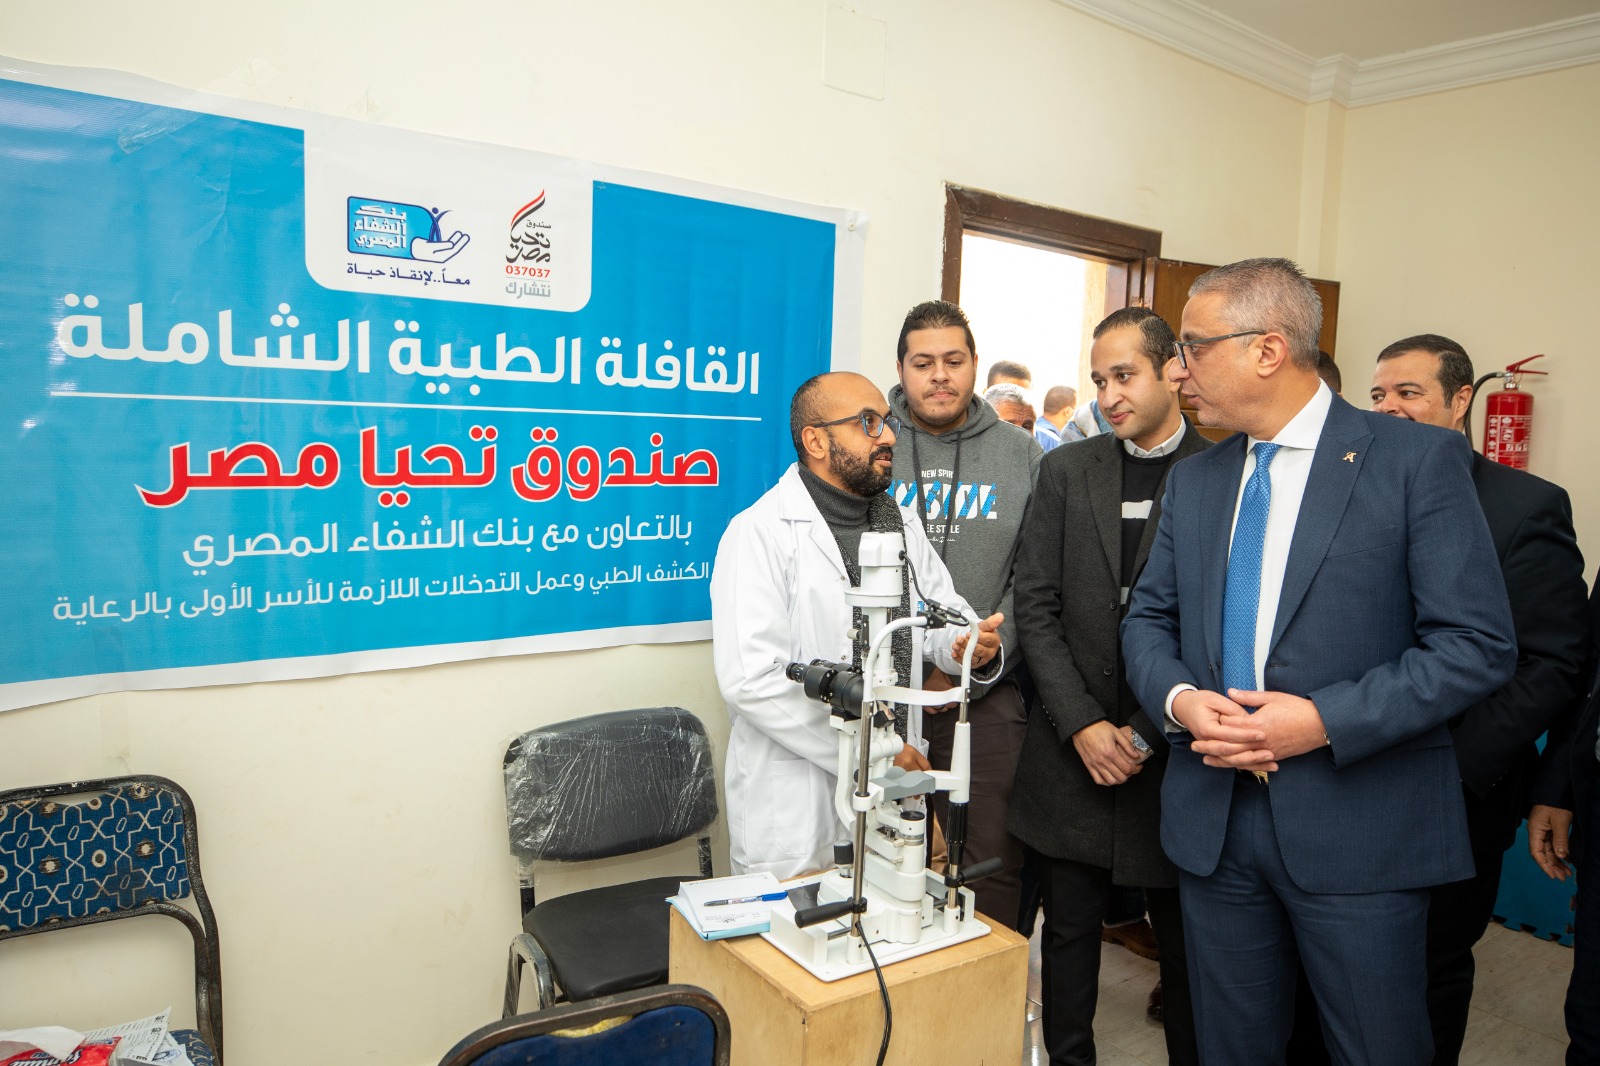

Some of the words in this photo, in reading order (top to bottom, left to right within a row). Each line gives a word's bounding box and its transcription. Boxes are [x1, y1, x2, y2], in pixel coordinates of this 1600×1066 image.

[354, 206, 406, 220] بنك
[354, 216, 406, 236] الشفاء
[526, 220, 551, 229] صندوق
[354, 234, 406, 249] المصري
[347, 262, 386, 279] حياة
[506, 265, 550, 278] 037037
[506, 282, 551, 299] نتشارك
[57, 293, 370, 373] الشاملة
[389, 320, 581, 395] الطبية
[596, 337, 759, 394] القافلة
[135, 442, 341, 508] مصر
[360, 425, 498, 508] تحيا
[511, 427, 719, 502] صندوق
[921, 469, 937, 478] NEW
[938, 469, 954, 479] SPIR
[347, 514, 465, 552] الشفاء
[472, 517, 534, 553] بنك
[541, 524, 579, 551] مع
[587, 514, 692, 549] بالتعاون
[936, 524, 960, 534] STLE
[182, 522, 338, 576] المصري
[425, 571, 520, 596] التدخلات
[525, 571, 585, 595] وعمل
[589, 565, 642, 595] الطبي
[646, 560, 709, 582] الكشف
[180, 582, 252, 617] الأولى
[257, 578, 333, 613] للأسر
[339, 577, 419, 605] اللازمة
[53, 591, 172, 625] بالرعاية
